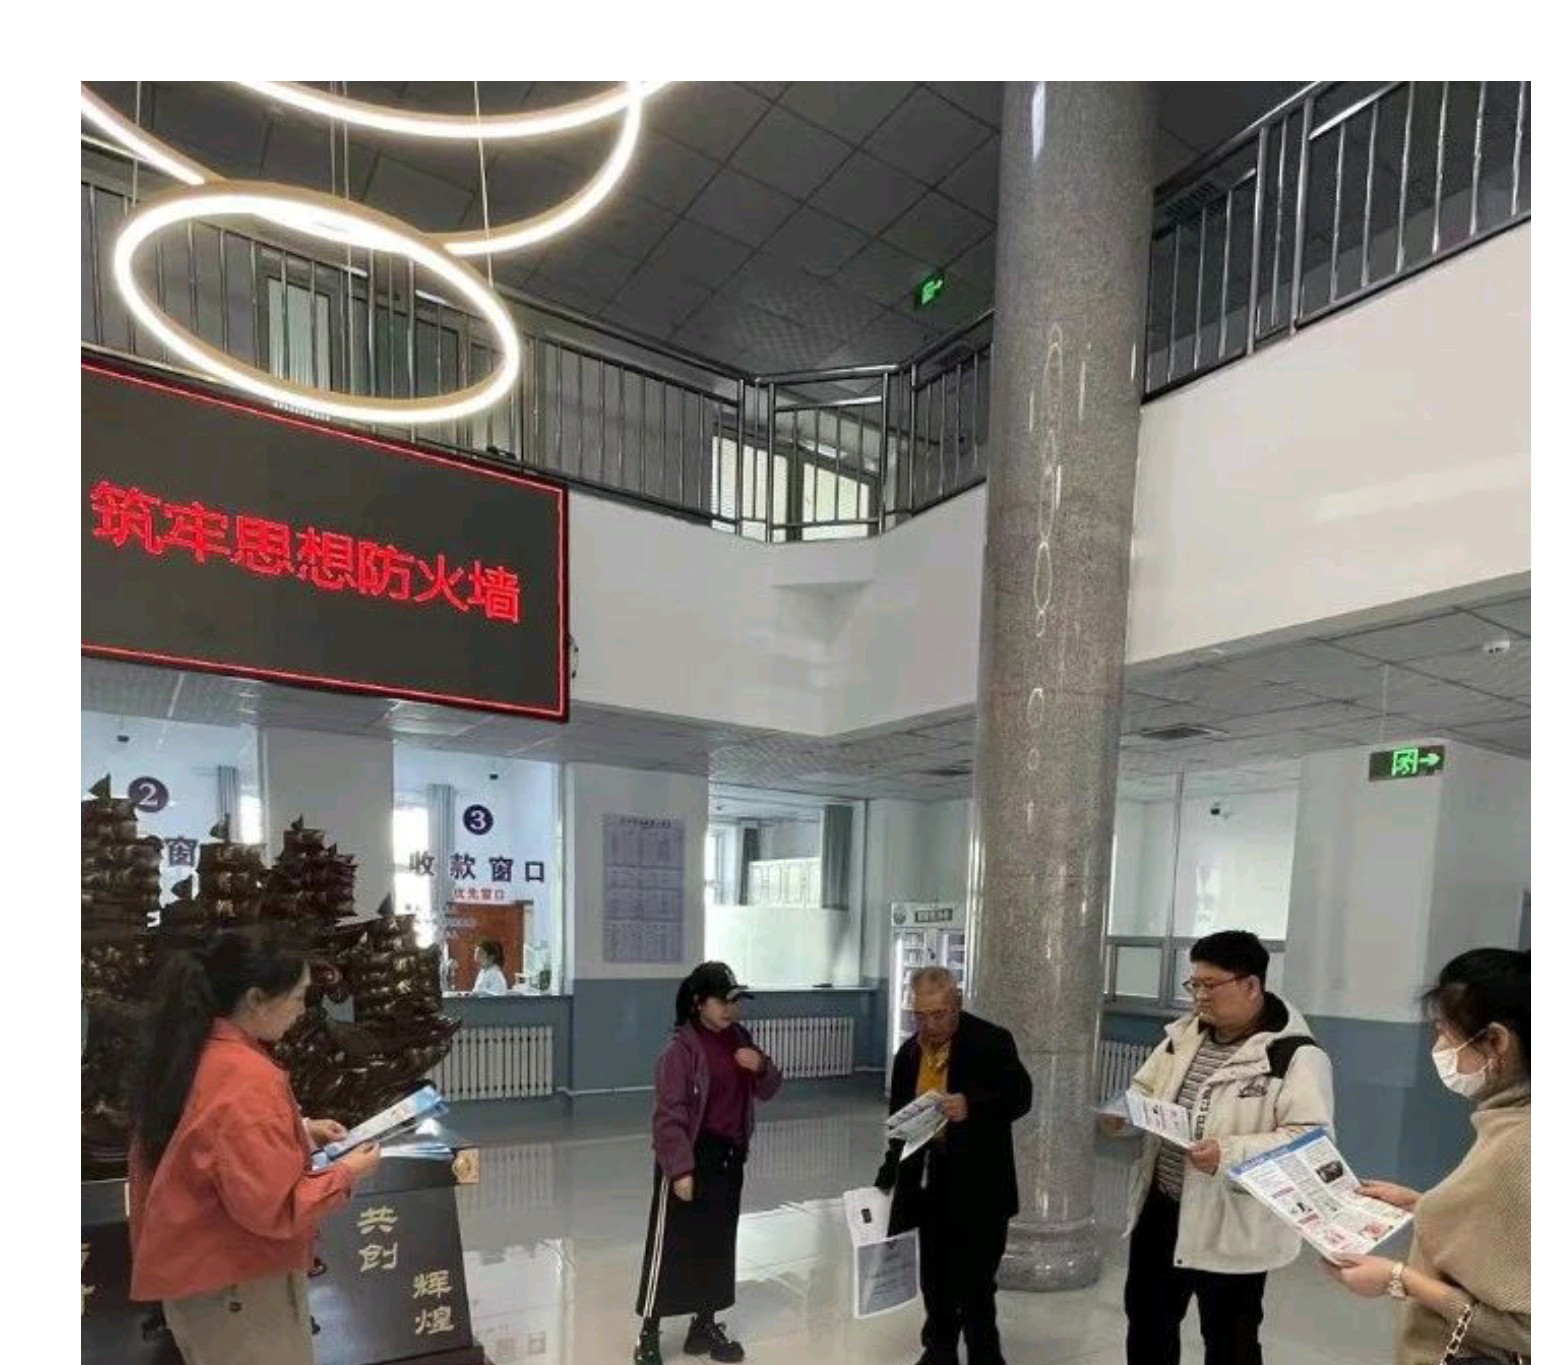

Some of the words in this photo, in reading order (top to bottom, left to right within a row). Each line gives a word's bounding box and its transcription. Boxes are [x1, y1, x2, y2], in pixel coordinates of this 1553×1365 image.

[90, 480, 521, 625] 筑牢思想防火墙
[409, 851, 545, 883] 收款窗口
